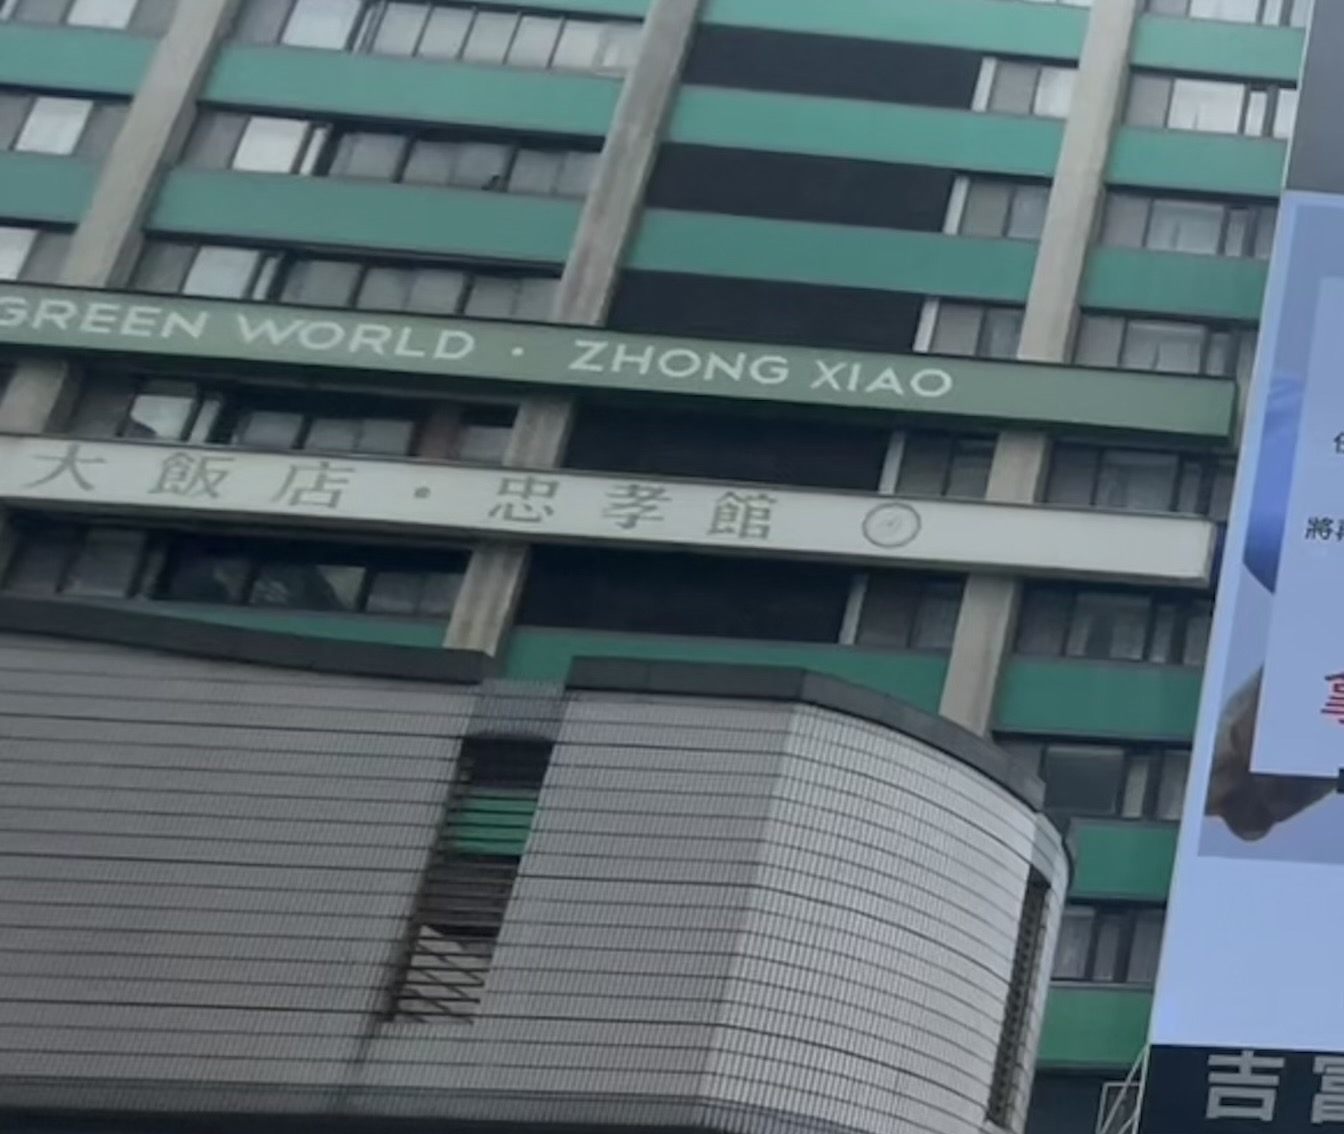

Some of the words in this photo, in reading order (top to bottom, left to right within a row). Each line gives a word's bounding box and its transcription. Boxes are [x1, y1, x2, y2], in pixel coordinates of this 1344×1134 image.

[0, 295, 209, 345] GREEN
[237, 312, 478, 361] WORLD
[568, 338, 790, 388] ZHONG
[811, 357, 954, 402] XIAO
